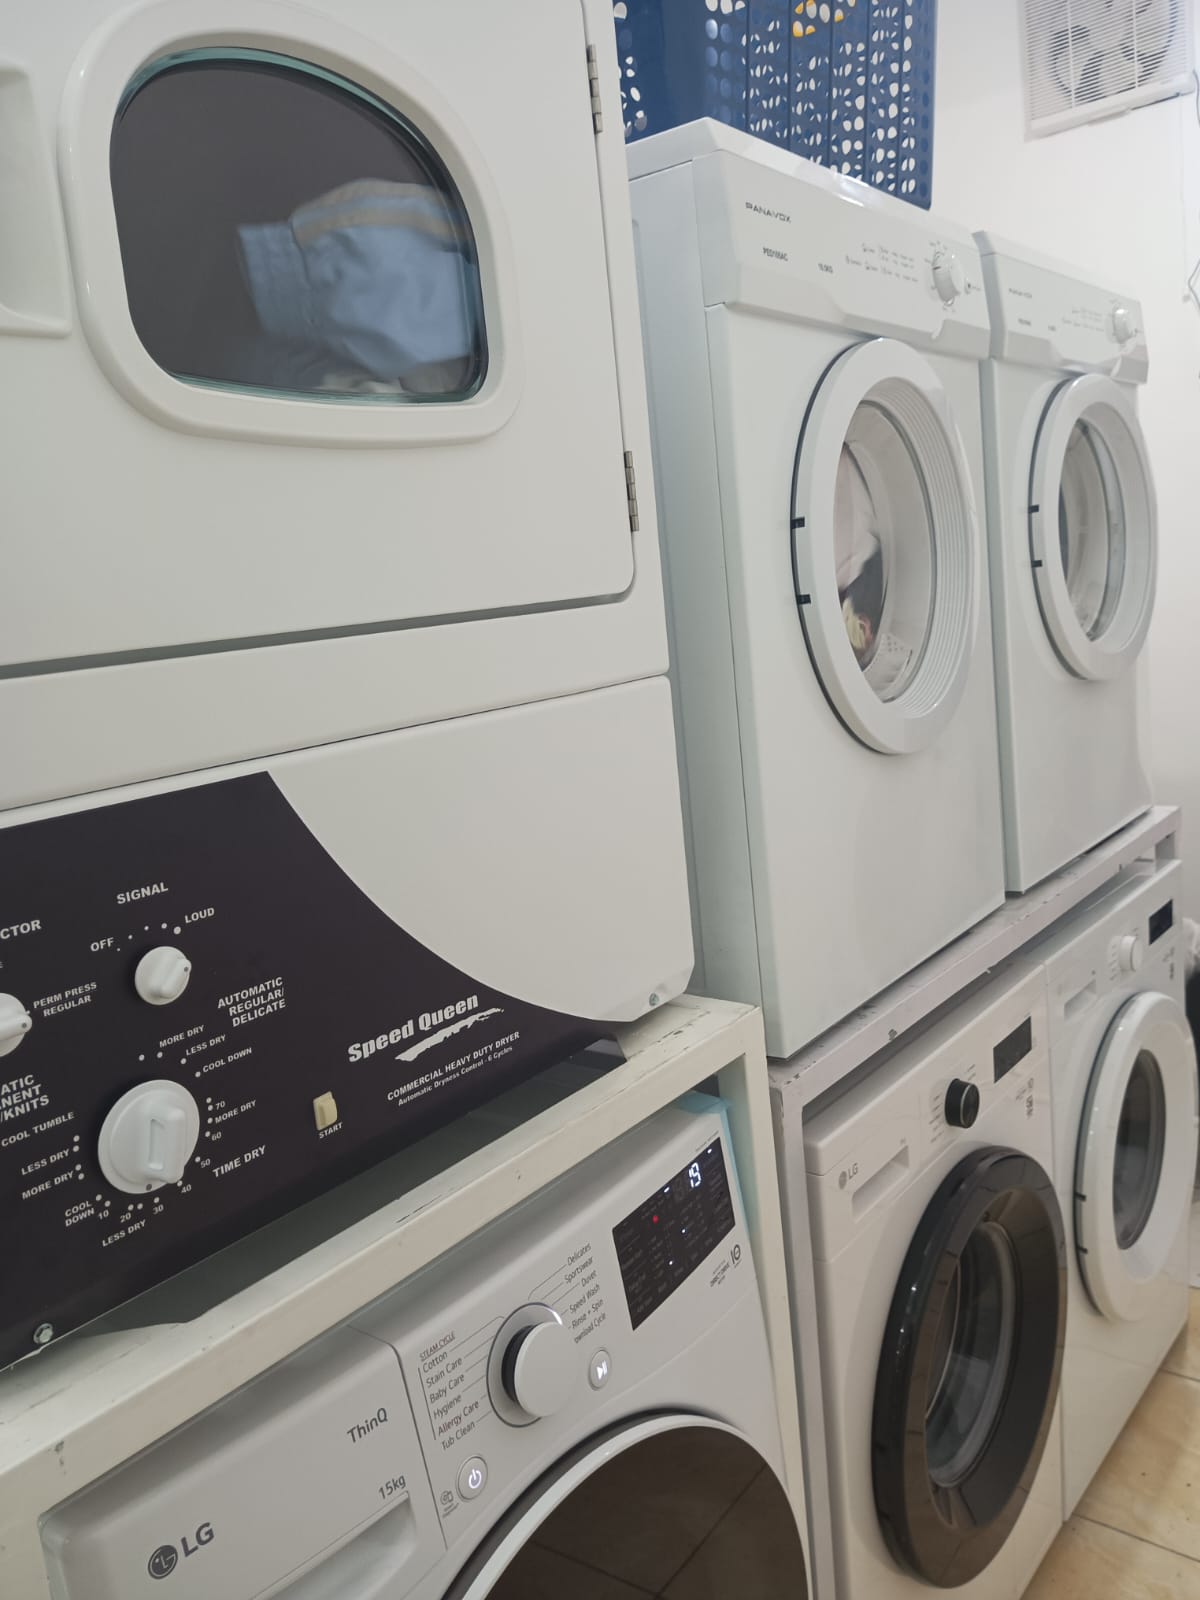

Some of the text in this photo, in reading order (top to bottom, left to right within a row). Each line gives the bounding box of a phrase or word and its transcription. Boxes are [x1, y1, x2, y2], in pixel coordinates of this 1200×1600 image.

[117, 882, 168, 904] SIGNAL
[185, 908, 215, 924] LOUD
[0, 919, 42, 940] CTOR
[91, 938, 114, 952] OFF
[33, 982, 97, 1008] PERM PRESS
[217, 977, 283, 1008] AUTOMATIC
[229, 987, 284, 1016] REGULAR/
[43, 995, 91, 1017] REGULAR
[232, 999, 286, 1027] DELICATE
[159, 1024, 204, 1048] MORE DRY
[348, 995, 479, 1063] Speed Queen
[186, 1034, 226, 1056] LESS DRY
[203, 1047, 252, 1073] COOL DOWN
[387, 1031, 520, 1101] COMMERCIAL HEAVY DUTY DRYER
[1, 1074, 35, 1096] ATIC
[398, 1085, 432, 1106] Automatic
[434, 1072, 460, 1088] Dryness
[460, 1059, 484, 1075] Control
[493, 1046, 513, 1059] Cycles
[0, 1083, 42, 1110] NENT
[215, 1101, 226, 1110] 70
[215, 1100, 257, 1124] MORE DRY
[1, 1111, 75, 1147] COOL TUMBLE
[211, 1131, 222, 1141] 60
[319, 1122, 343, 1139] START
[21, 1149, 70, 1176] LESS DRY
[200, 1158, 211, 1168] 50
[212, 1145, 266, 1178] TIME DRY
[848, 1162, 859, 1180] LG
[22, 1171, 74, 1200] MORE DRY
[181, 1184, 192, 1194] 40
[65, 1201, 92, 1217] COOL
[65, 1211, 95, 1227] DOWN
[98, 1209, 109, 1220] 10
[120, 1213, 131, 1223] 20
[153, 1204, 164, 1214] 30
[102, 1220, 146, 1247] LESS DRY
[574, 1322, 594, 1344] ownload
[423, 1351, 448, 1373] Cotton
[426, 1358, 462, 1388] Stain Care
[430, 1374, 464, 1404] Baby Care
[434, 1395, 461, 1419] Hygiene
[439, 1400, 479, 1435] Allergy Care
[347, 1408, 388, 1443] ThinQ
[442, 1421, 475, 1450] Tub Clean
[378, 1475, 407, 1500] 15kg
[180, 1521, 215, 1558] LG
